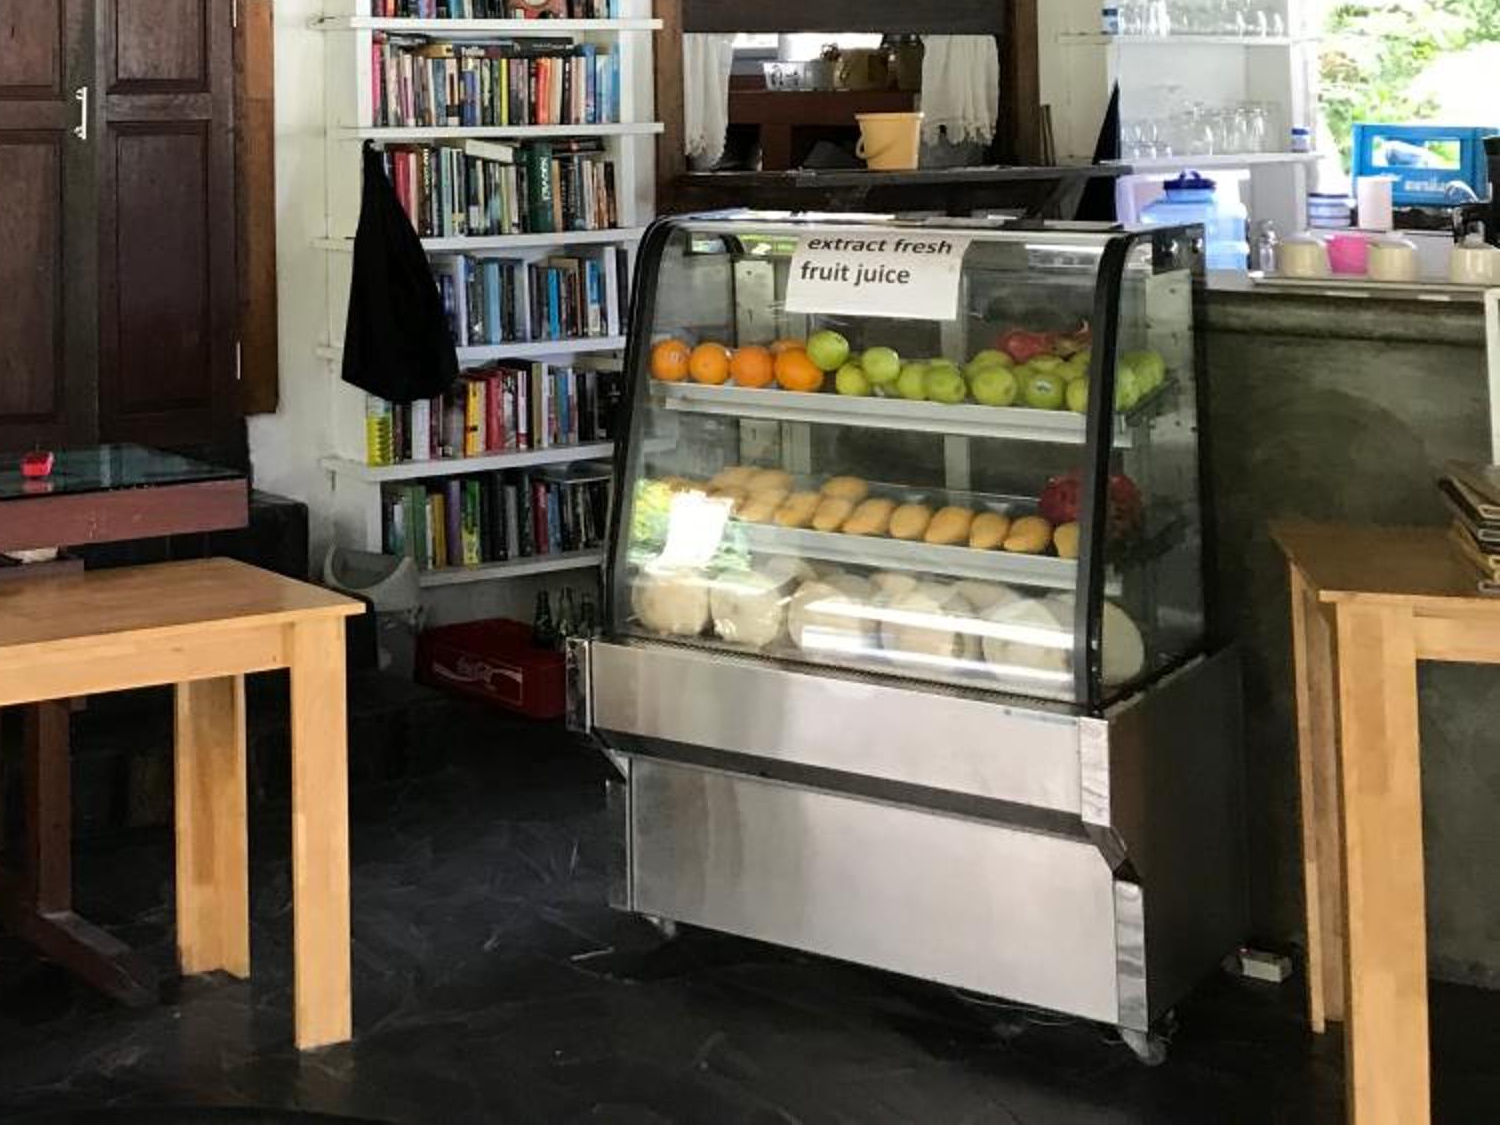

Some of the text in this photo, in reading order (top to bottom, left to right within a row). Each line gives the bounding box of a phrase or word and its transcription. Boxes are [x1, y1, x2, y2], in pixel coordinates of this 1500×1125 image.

[807, 237, 953, 255] extract fresh
[801, 260, 911, 287] fruit juice
